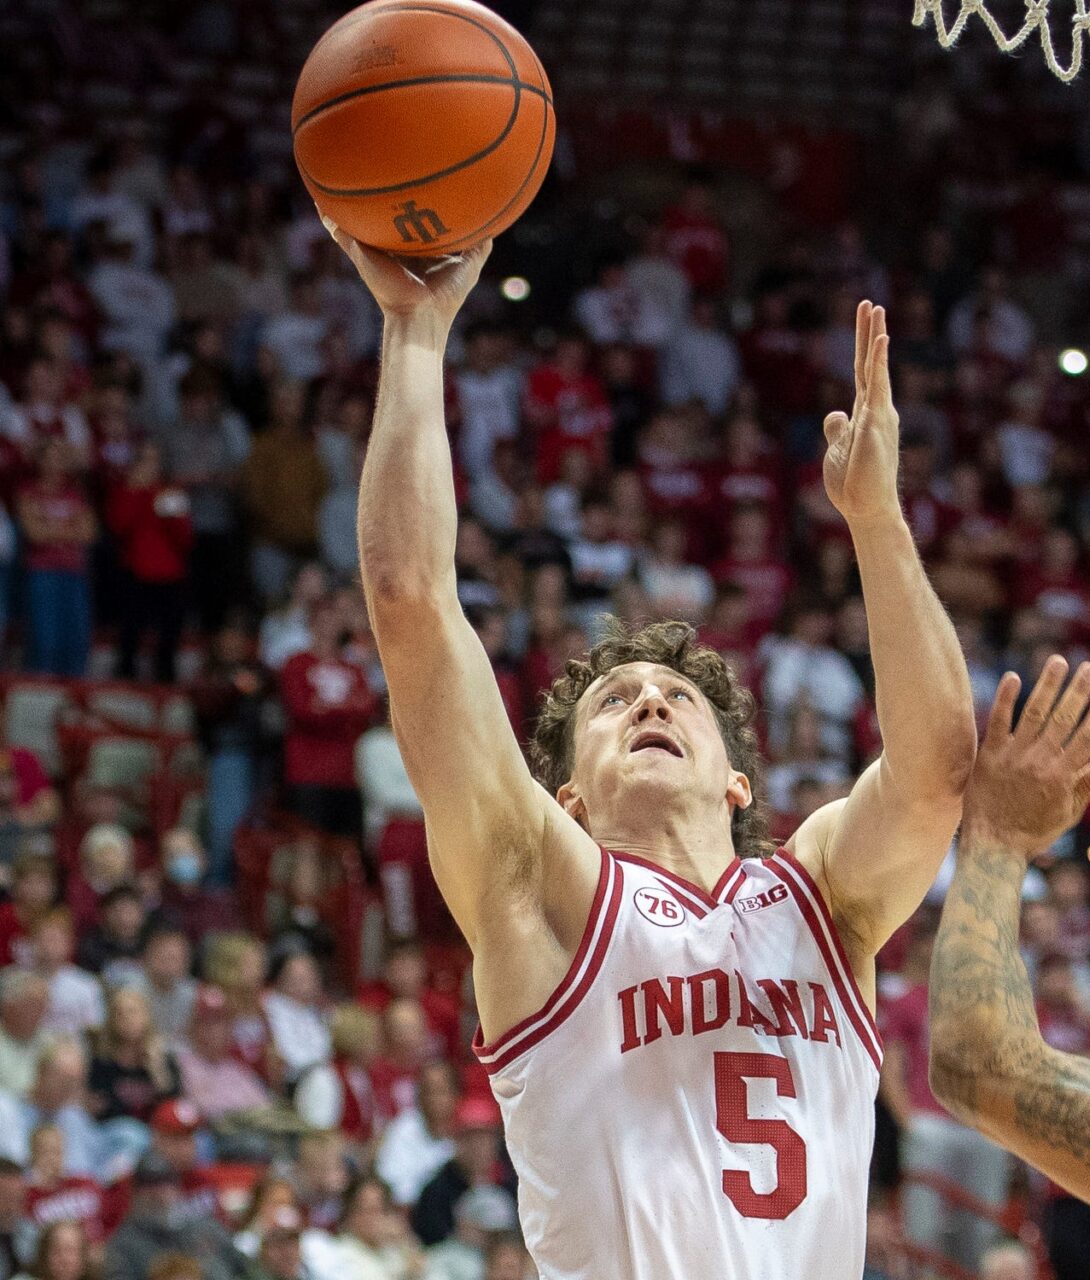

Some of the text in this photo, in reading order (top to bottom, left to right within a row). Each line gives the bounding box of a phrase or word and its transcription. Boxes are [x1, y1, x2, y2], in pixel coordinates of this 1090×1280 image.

[738, 883, 789, 913] BIG
[617, 968, 842, 1054] INDIANA
[713, 1051, 807, 1221] 5
